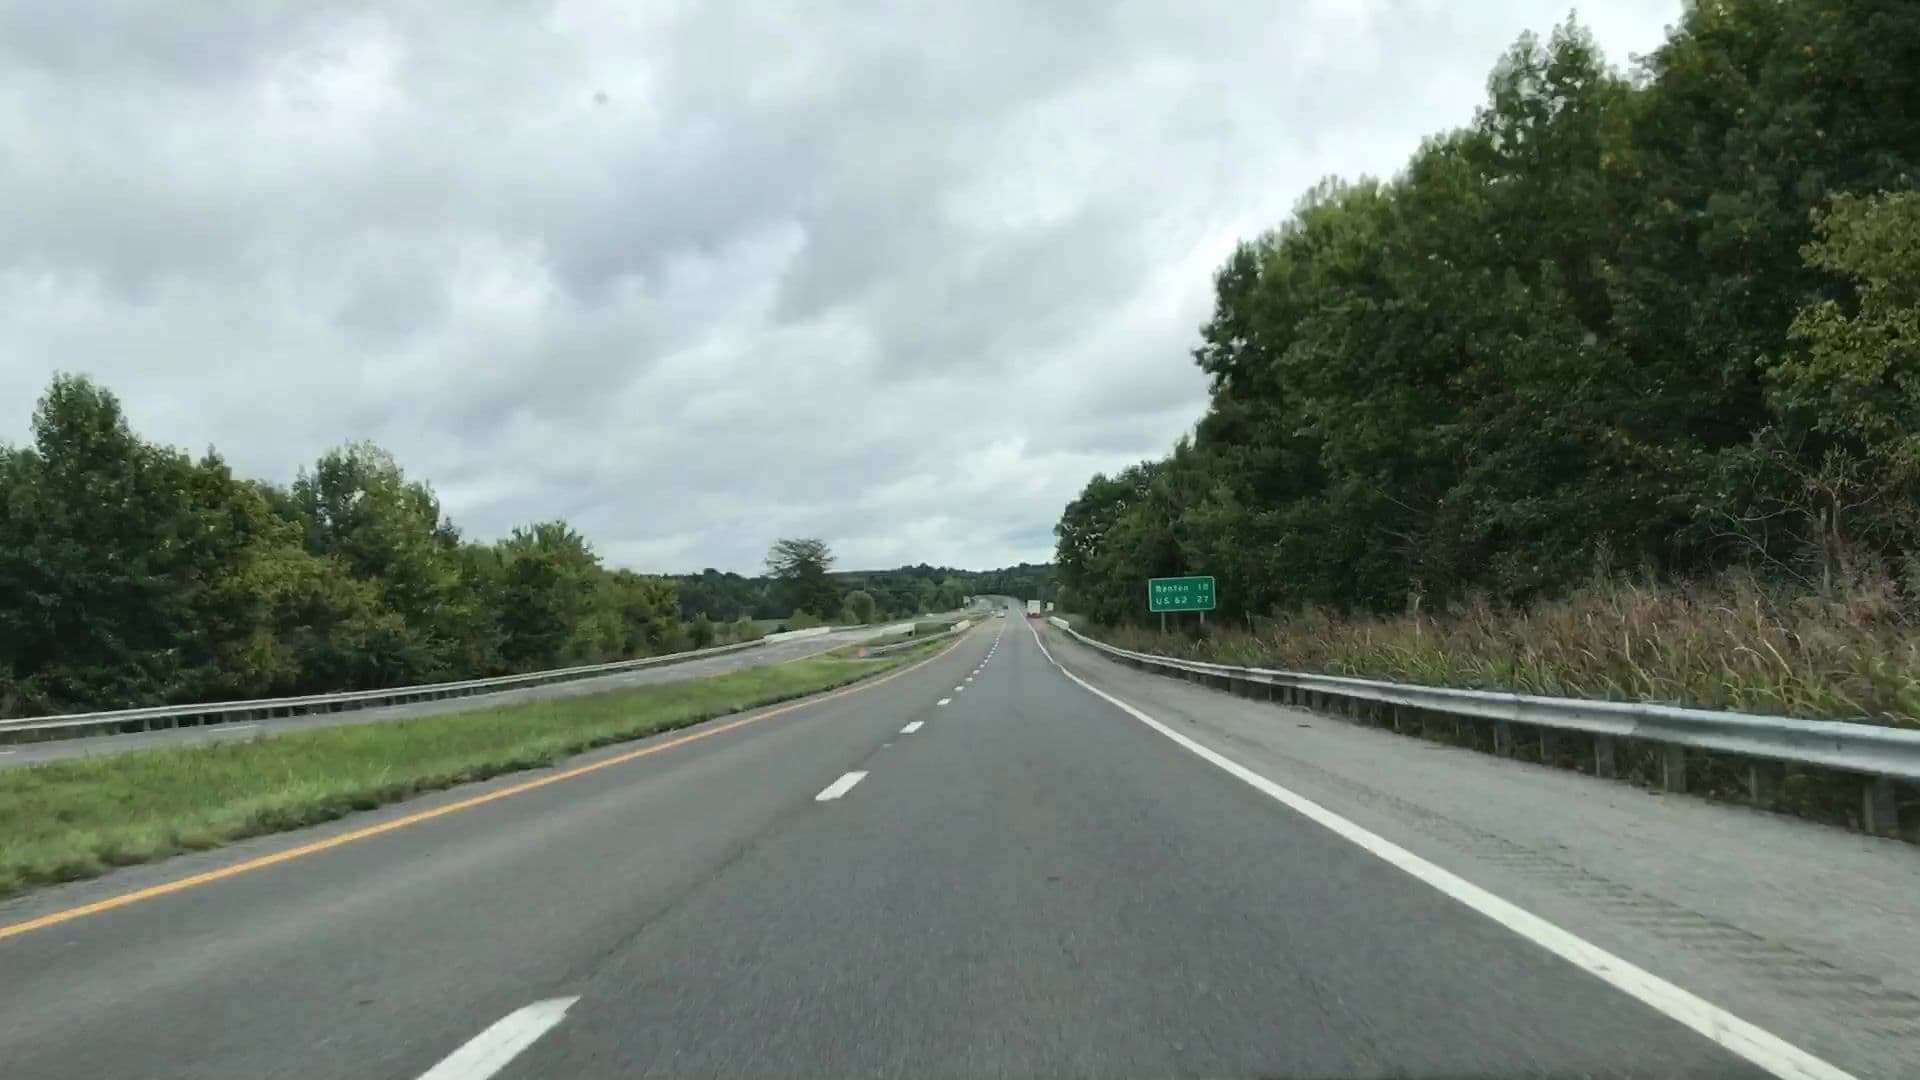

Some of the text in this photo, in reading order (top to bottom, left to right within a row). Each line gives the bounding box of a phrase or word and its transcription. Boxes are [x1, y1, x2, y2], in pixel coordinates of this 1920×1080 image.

[1155, 595, 1209, 605] US 62 27
